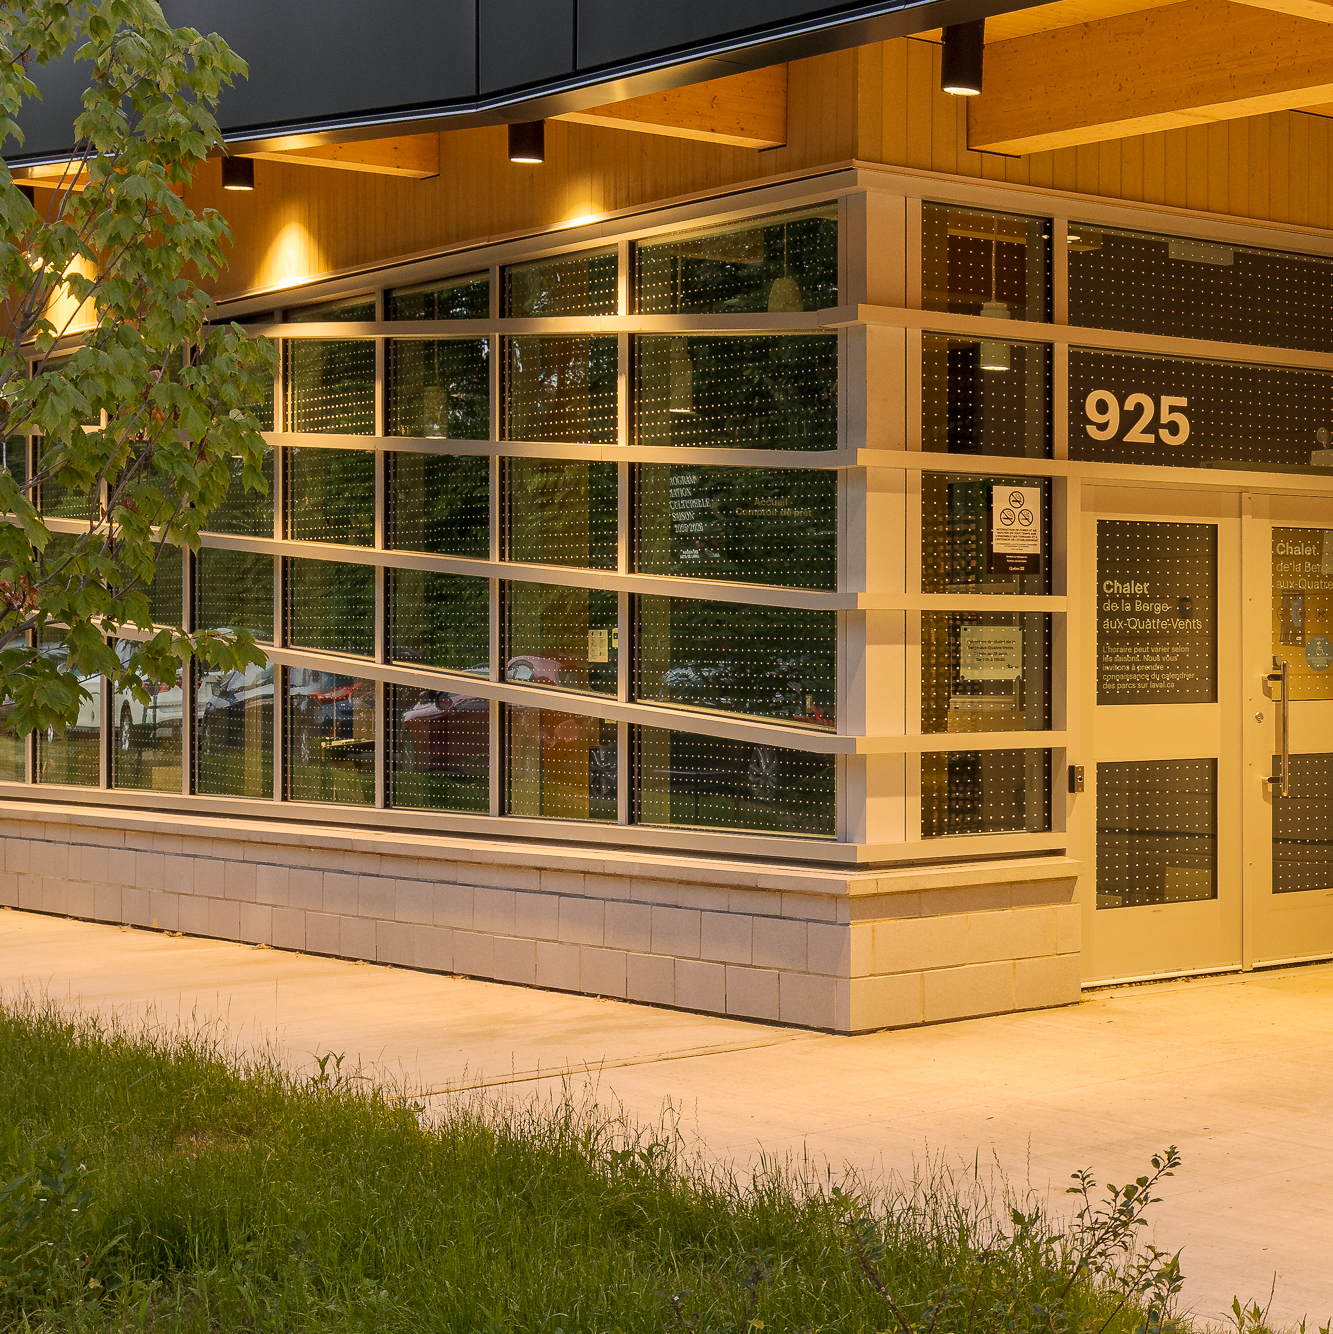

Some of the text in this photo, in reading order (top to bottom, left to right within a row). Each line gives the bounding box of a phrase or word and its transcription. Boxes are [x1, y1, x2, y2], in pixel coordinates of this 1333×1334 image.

[1084, 390, 1190, 446] 925
[670, 498, 711, 510] CULTURELLE
[672, 511, 695, 521] SAISON
[736, 508, 812, 517] Comptoir de prêt
[1276, 542, 1317, 556] Chalet
[1276, 561, 1289, 572] de
[1293, 561, 1301, 572] la
[1103, 580, 1149, 594] Chalet
[1103, 599, 1172, 614] de la Berge-
[1103, 618, 1202, 630] aux-Quatre-Vents
[1138, 663, 1164, 672] prendre
[1117, 682, 1136, 690] parcs
